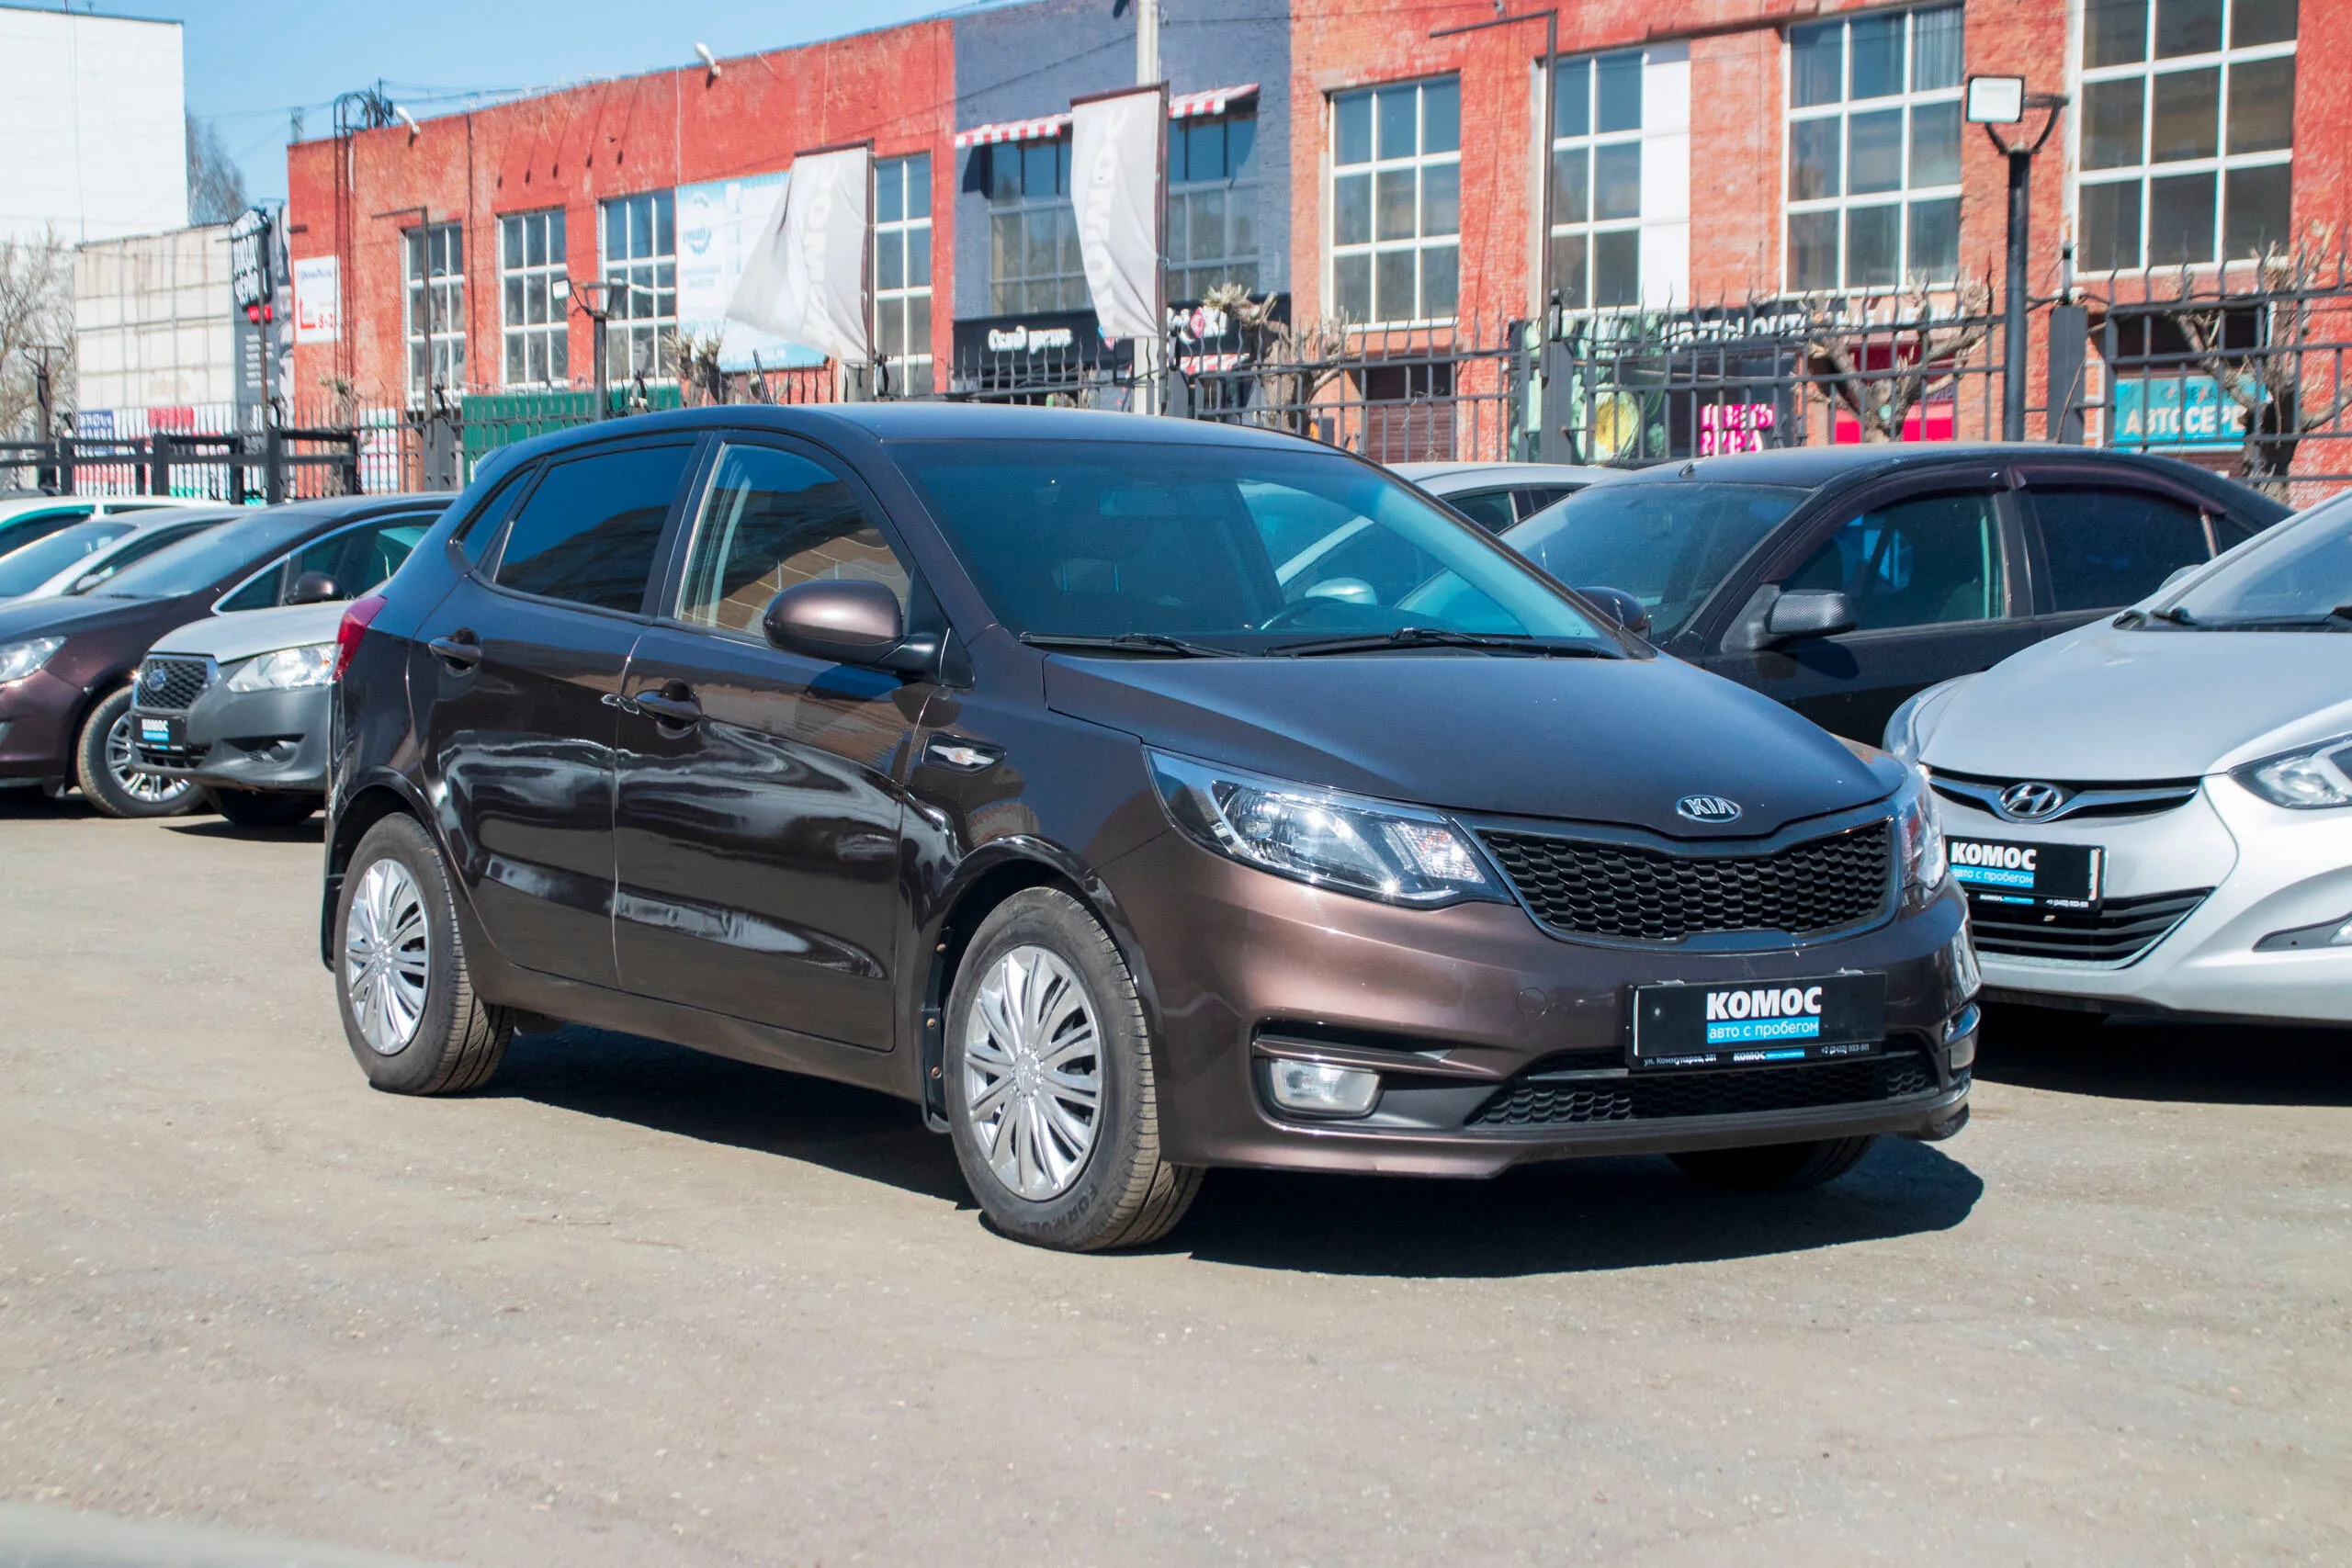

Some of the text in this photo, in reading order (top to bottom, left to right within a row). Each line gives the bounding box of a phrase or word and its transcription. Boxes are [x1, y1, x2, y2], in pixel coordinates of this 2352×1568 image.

[1684, 797, 1735, 816] KIA
[1951, 841, 2037, 871] КОМОС
[1951, 868, 2033, 885] авто с пробегом
[1706, 986, 1823, 1021] КОМОС
[1709, 1021, 1819, 1039] авто с пробегом
